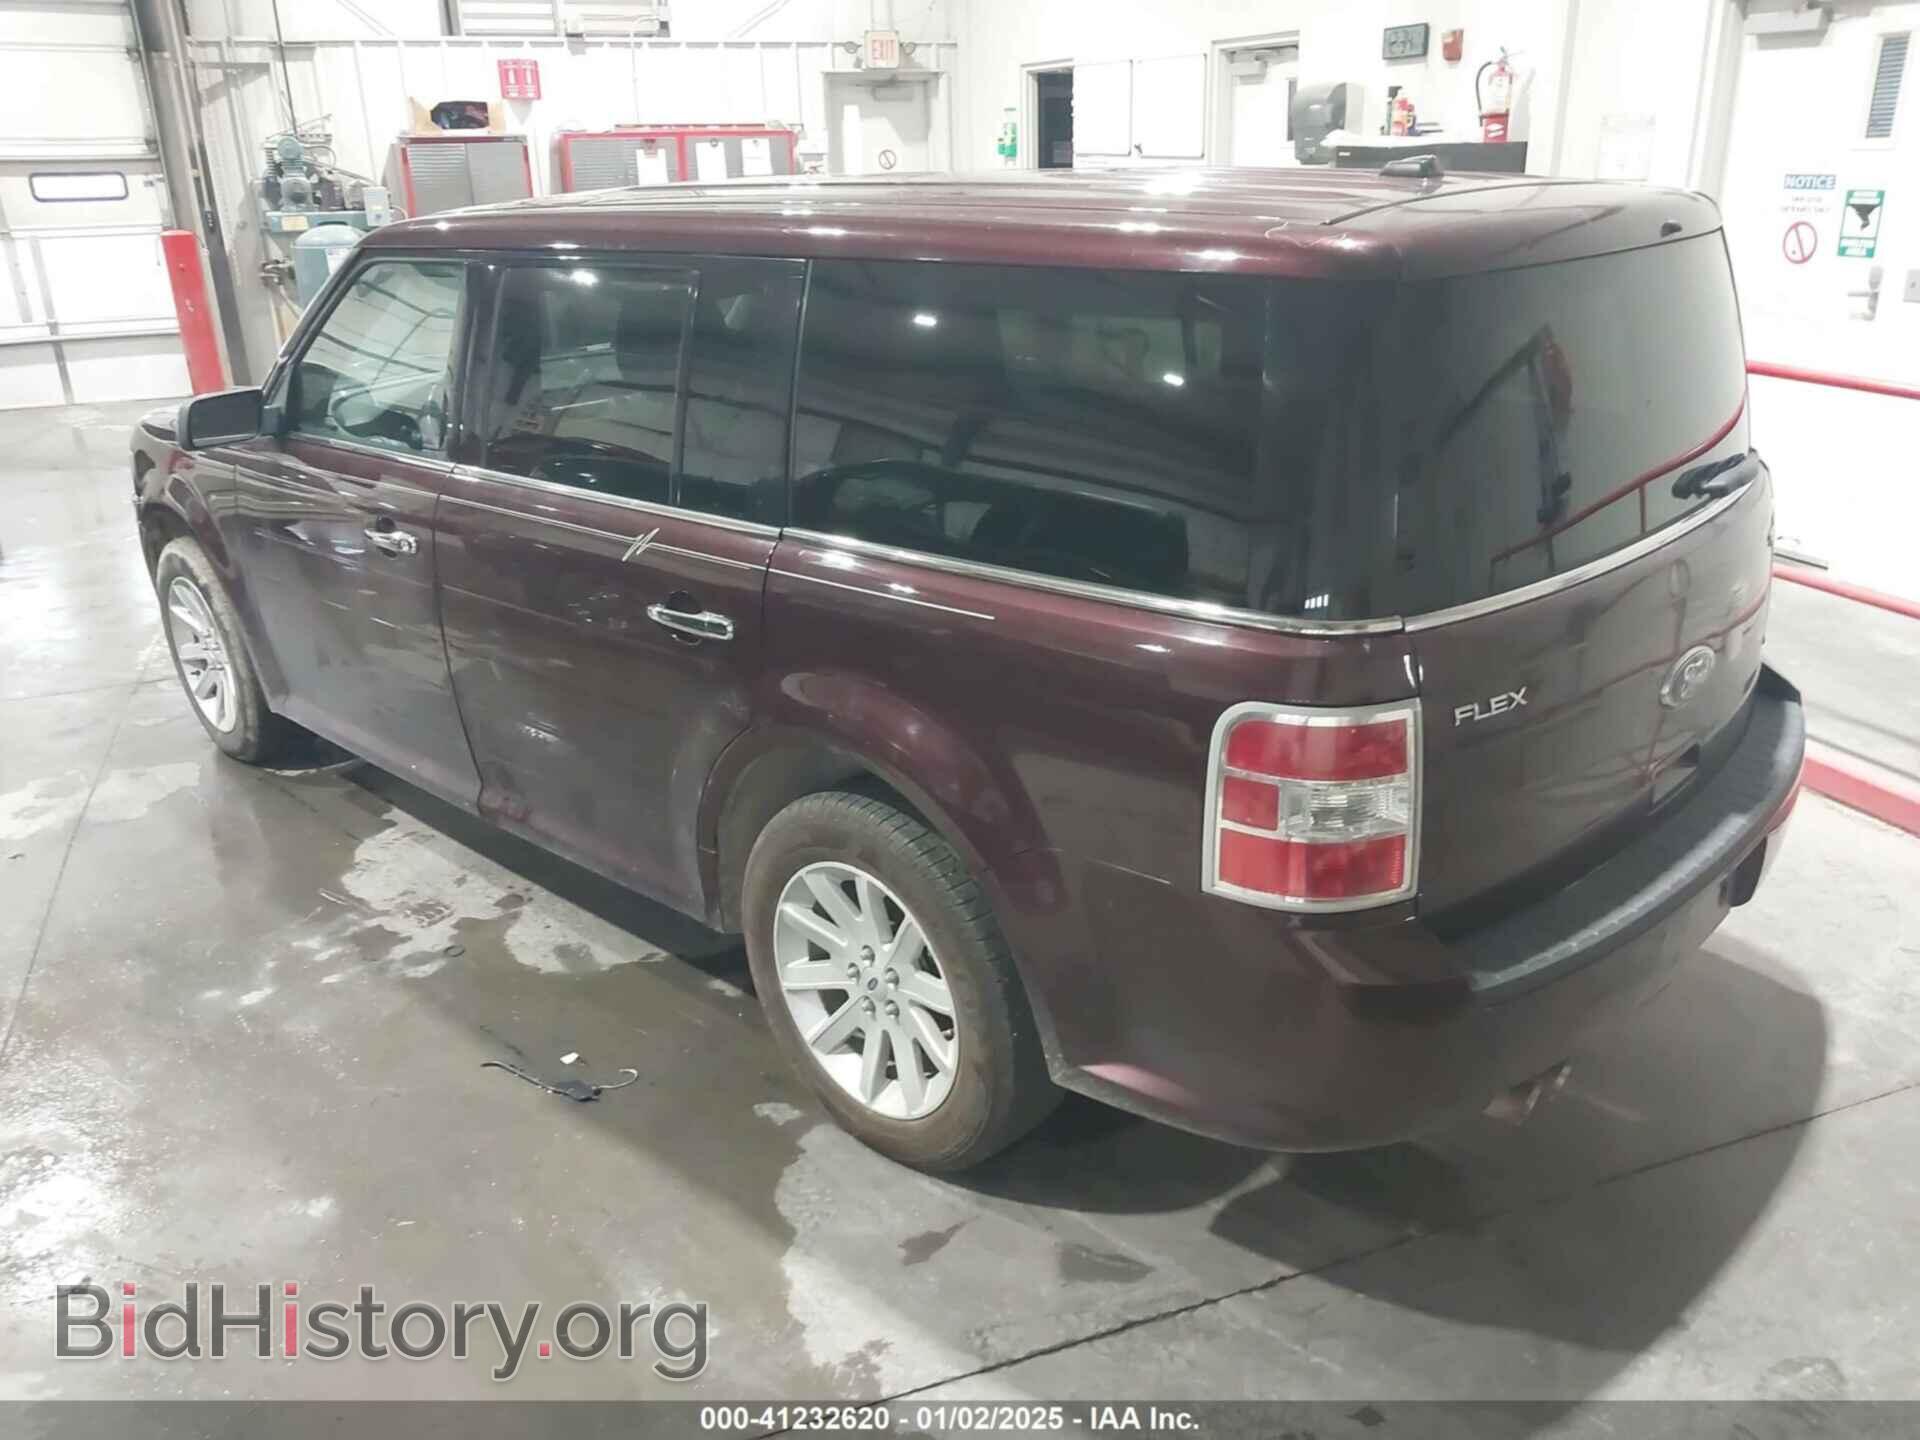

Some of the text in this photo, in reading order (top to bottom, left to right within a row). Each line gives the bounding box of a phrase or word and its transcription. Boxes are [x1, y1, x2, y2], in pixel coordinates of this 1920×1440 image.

[872, 40, 896, 60] EXIT
[1785, 175, 1834, 188] NOTICE
[1455, 686, 1528, 727] FLEX
